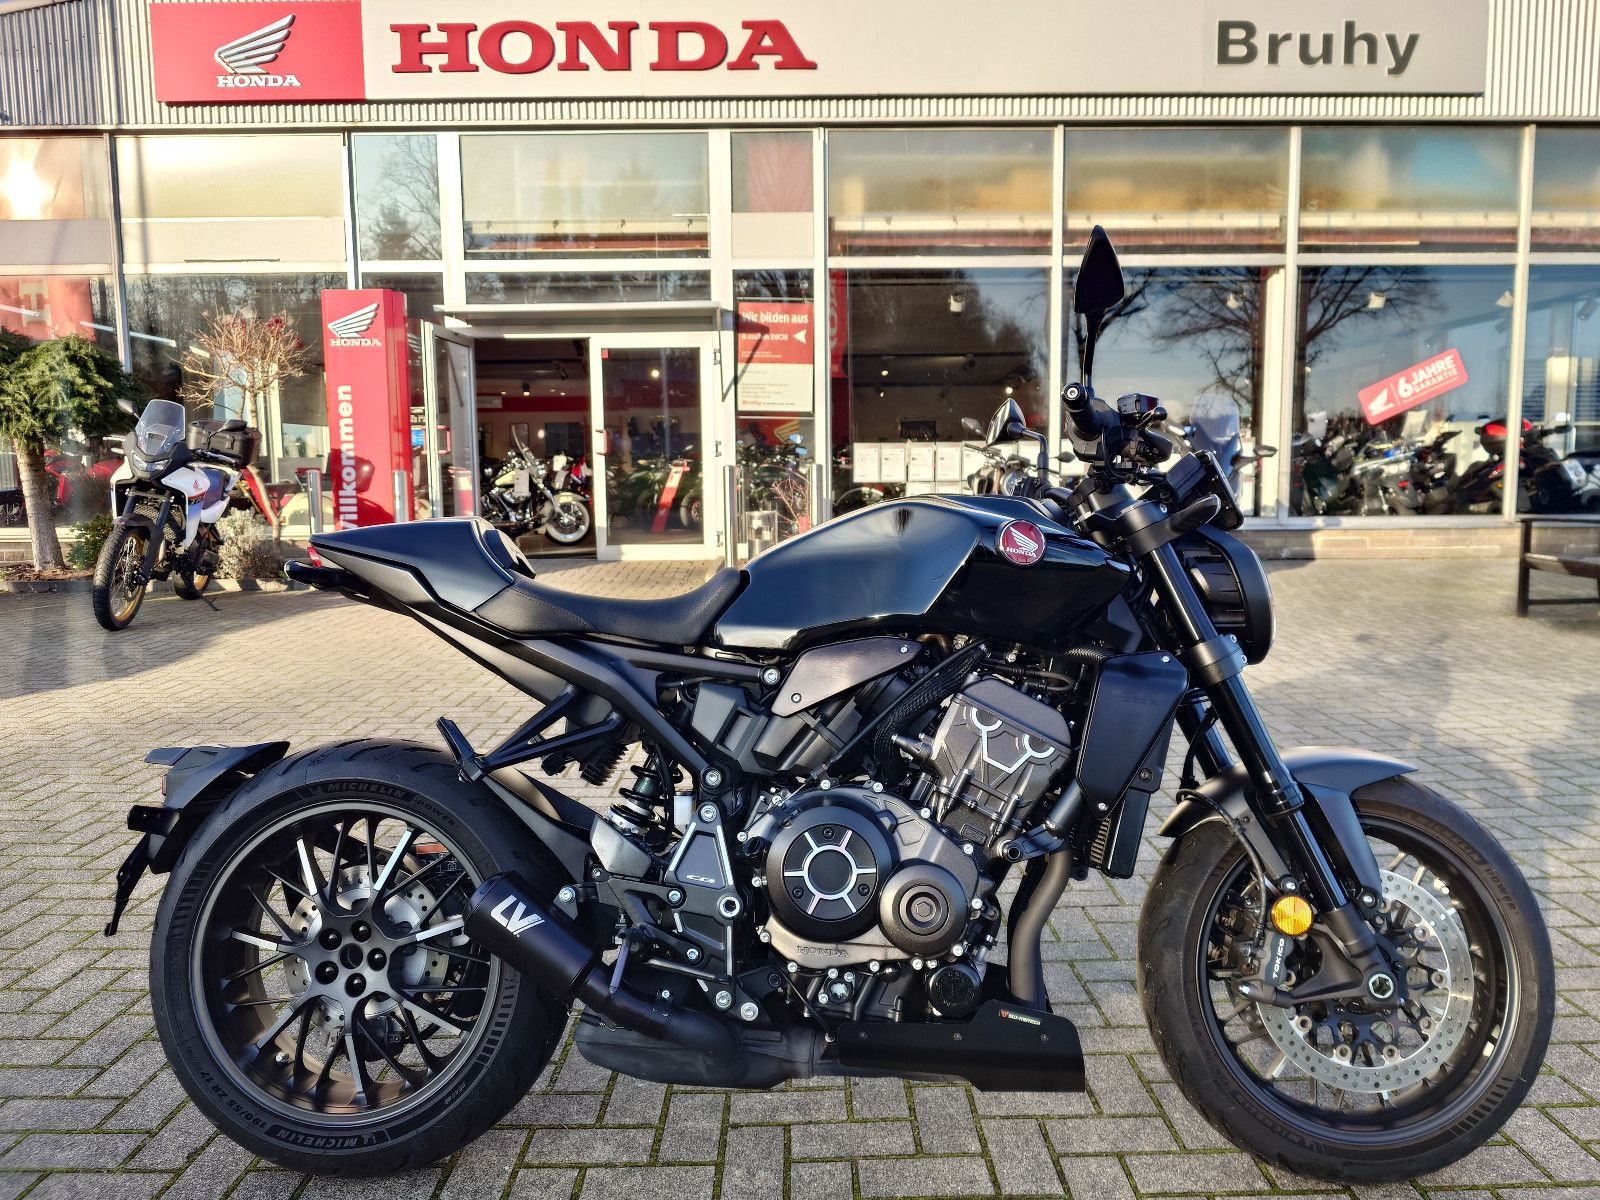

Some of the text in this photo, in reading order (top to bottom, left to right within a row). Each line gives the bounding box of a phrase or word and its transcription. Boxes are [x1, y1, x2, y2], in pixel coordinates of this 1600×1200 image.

[389, 19, 818, 74] HONDA
[1217, 20, 1420, 75] Bruhy
[216, 74, 301, 87] HONDA
[742, 311, 809, 324] Wir bilden aus
[330, 338, 382, 347] HONDA
[1397, 354, 1456, 398] 6 JAHRE
[1413, 368, 1459, 393] GARANTIE
[1006, 547, 1037, 557] HONDA
[327, 781, 457, 826] MICHELIN POWER
[490, 894, 543, 934] LV
[797, 945, 851, 958] HONDA
[1272, 938, 1285, 979] TOKICO
[276, 1129, 358, 1148] MICHELIN
